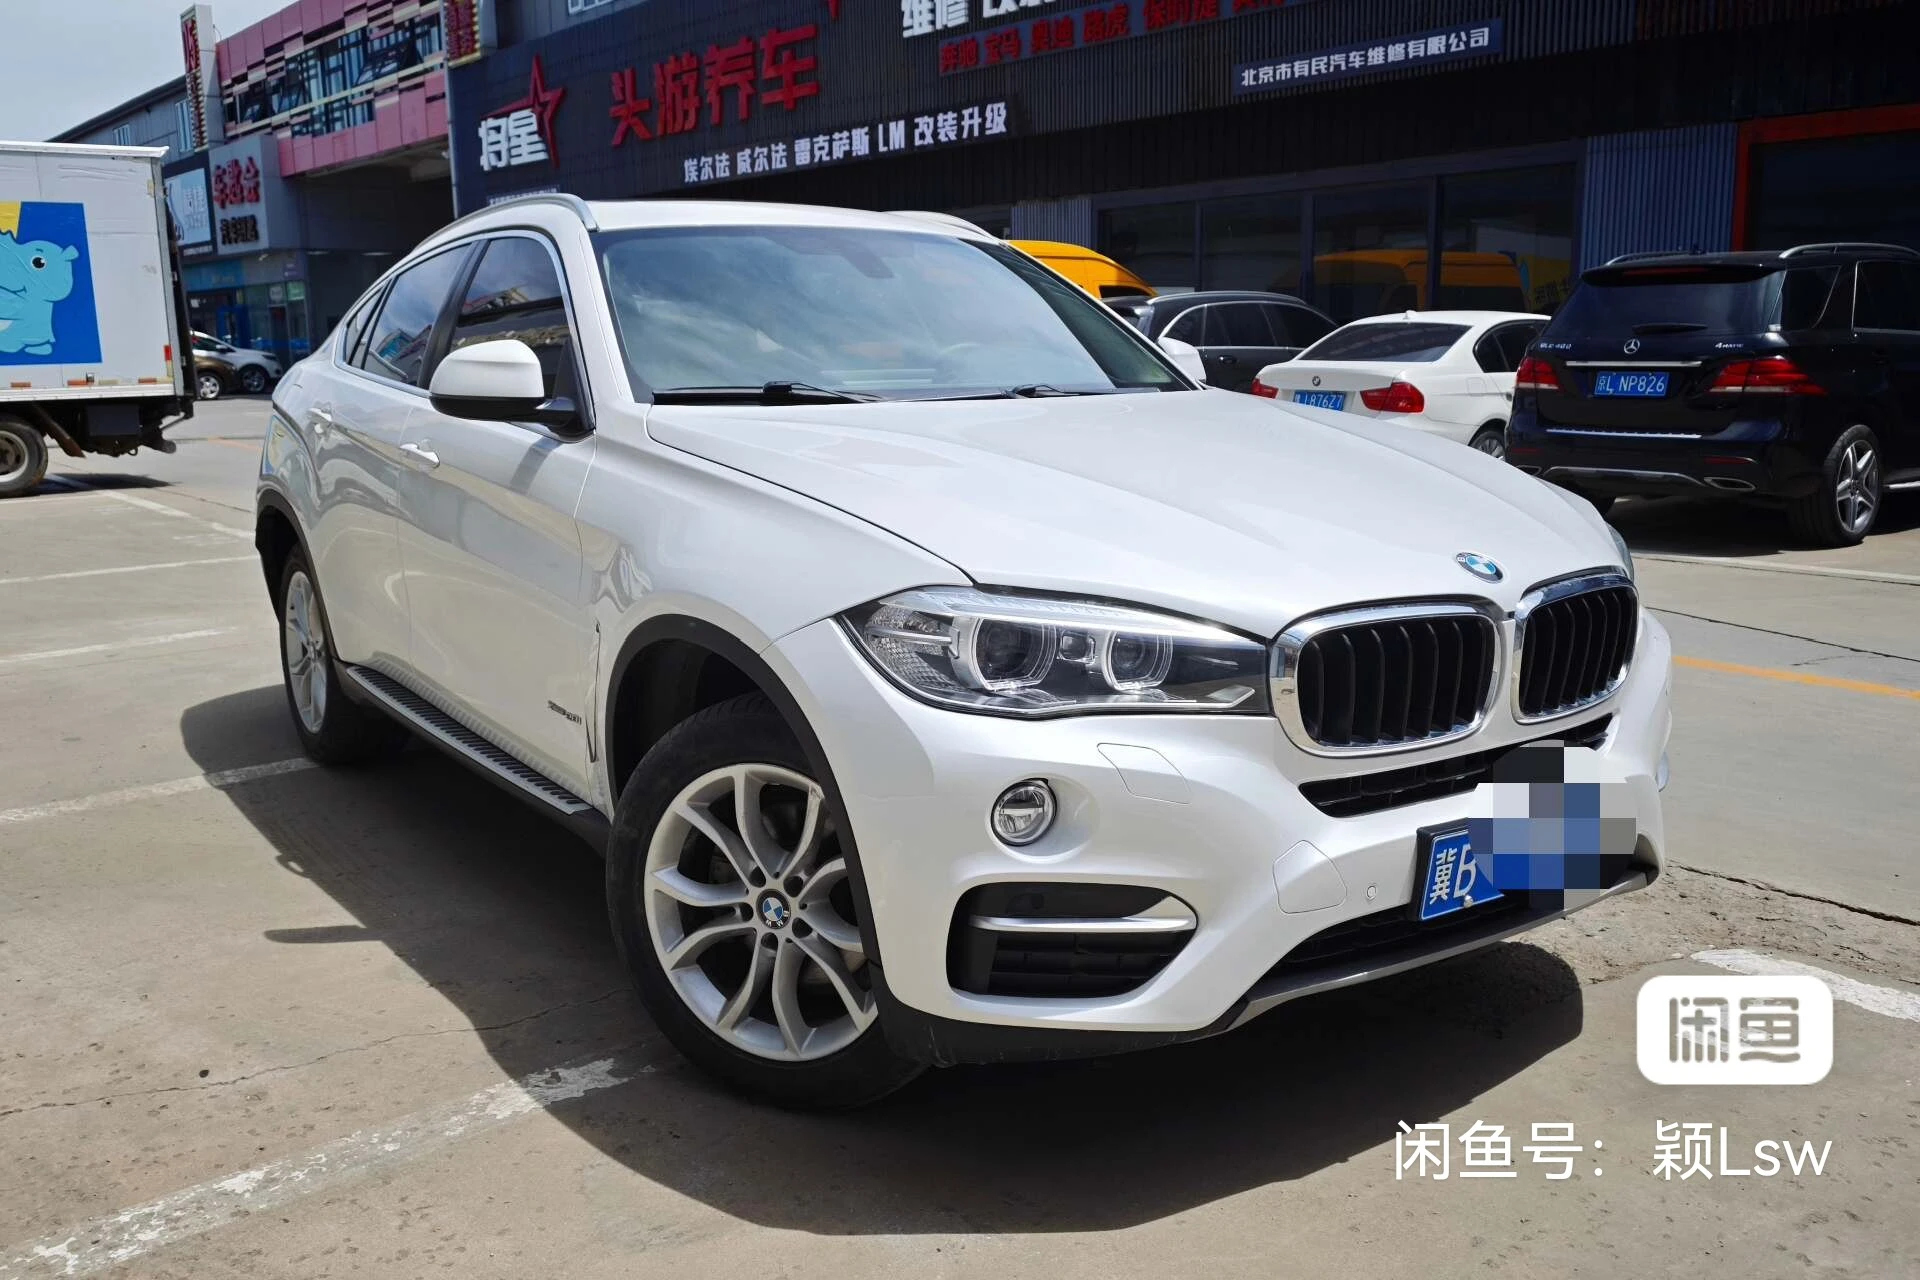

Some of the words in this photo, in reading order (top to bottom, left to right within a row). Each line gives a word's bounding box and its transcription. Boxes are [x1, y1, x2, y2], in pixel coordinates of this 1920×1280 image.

[609, 24, 820, 147] 头游养车
[1241, 27, 1490, 87] 北京市有民汽车维修有限公司
[684, 151, 730, 183] 埃尔法
[736, 143, 787, 175] 威尔法
[794, 127, 869, 166] 雷克萨斯
[878, 119, 905, 152] LM
[914, 101, 1007, 146] 改装升级
